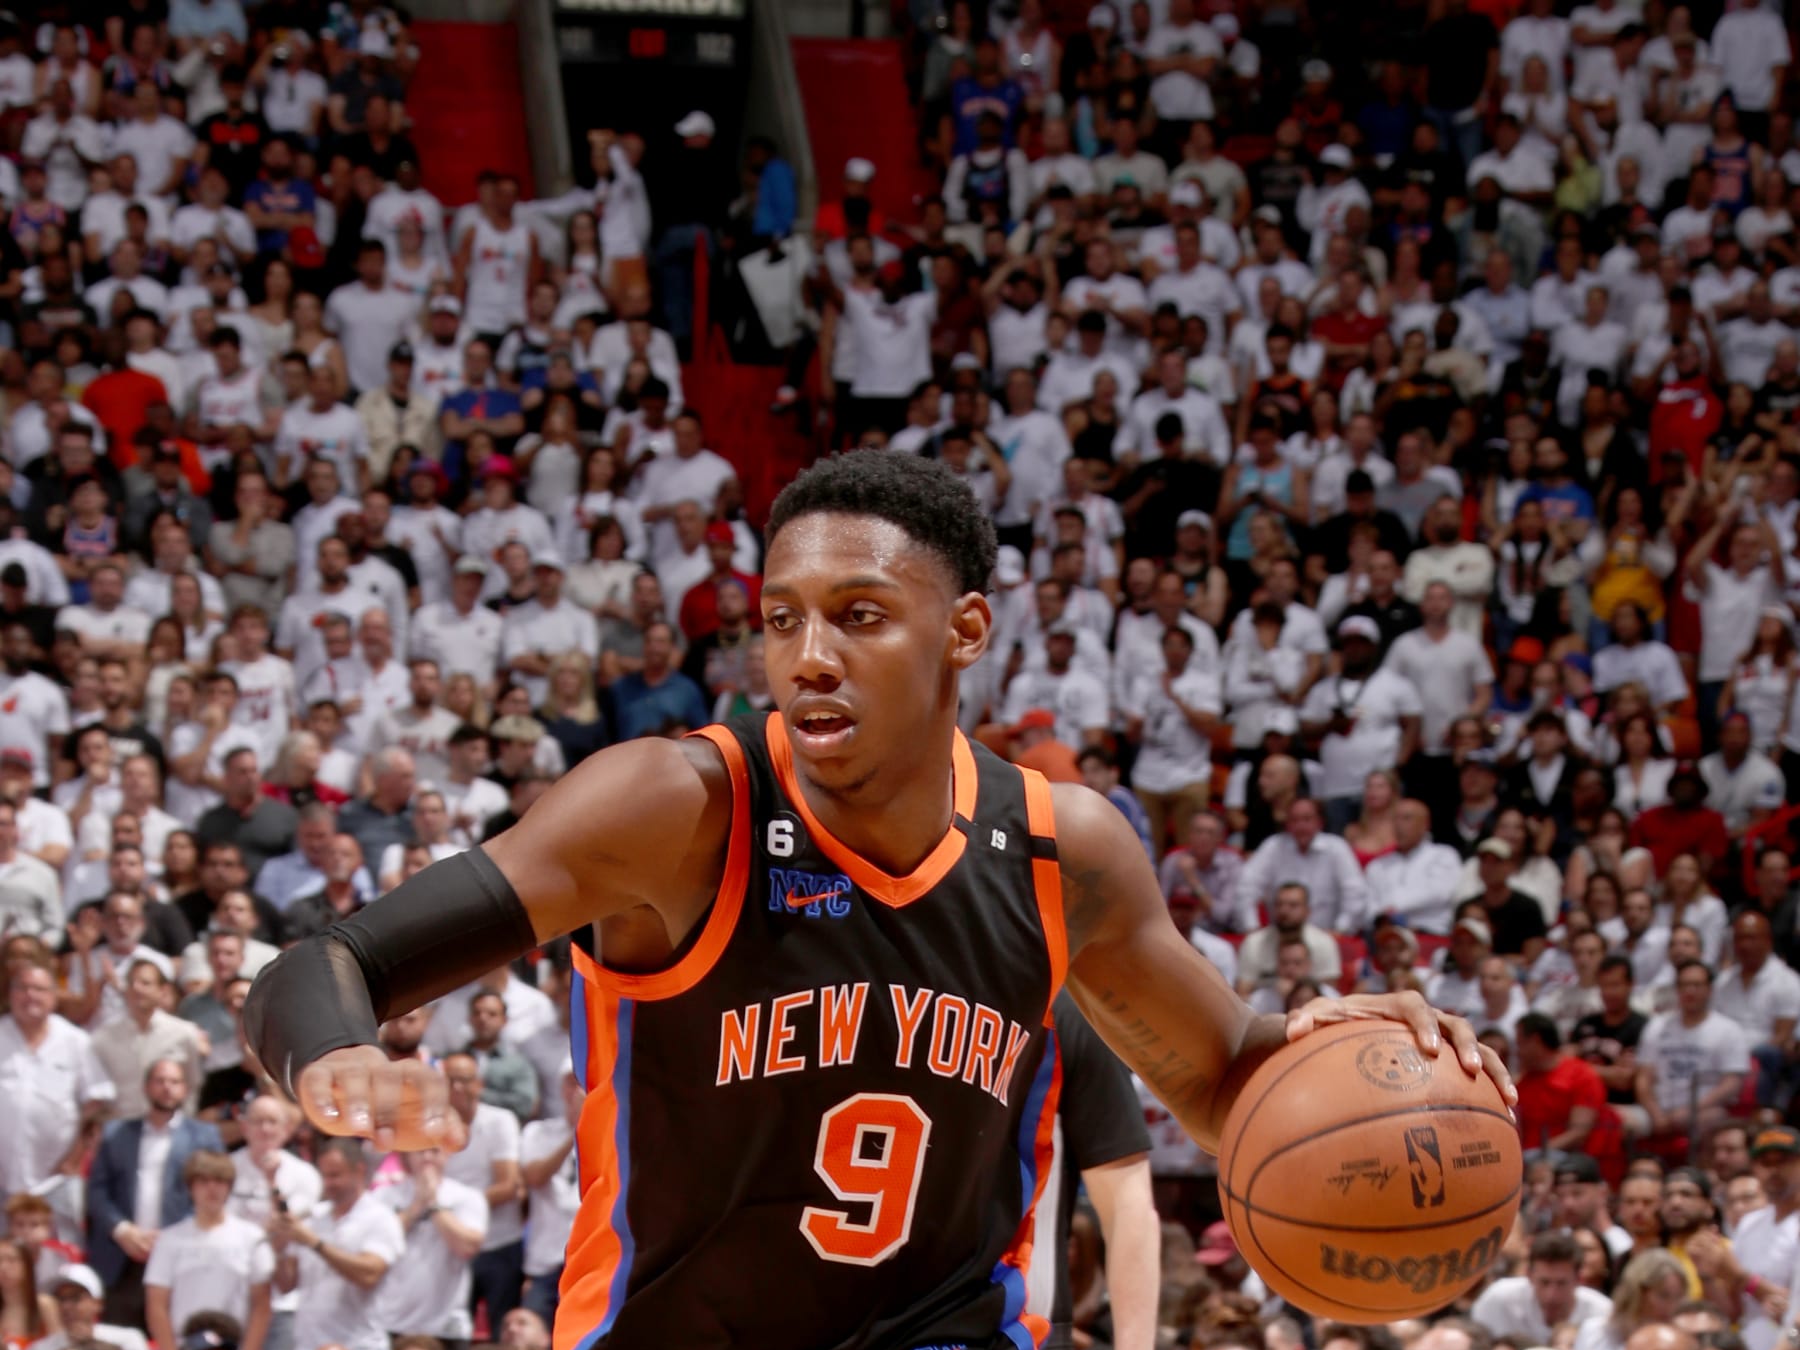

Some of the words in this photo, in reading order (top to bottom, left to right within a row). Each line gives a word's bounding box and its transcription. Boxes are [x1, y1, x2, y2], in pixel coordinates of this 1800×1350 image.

[767, 820, 794, 857] 6
[991, 829, 1007, 850] 19
[769, 867, 852, 918] NYC
[716, 982, 870, 1086] NEW
[889, 984, 1030, 1107] YORK
[799, 1093, 932, 1267] 9
[1320, 1226, 1502, 1294] Wilson
